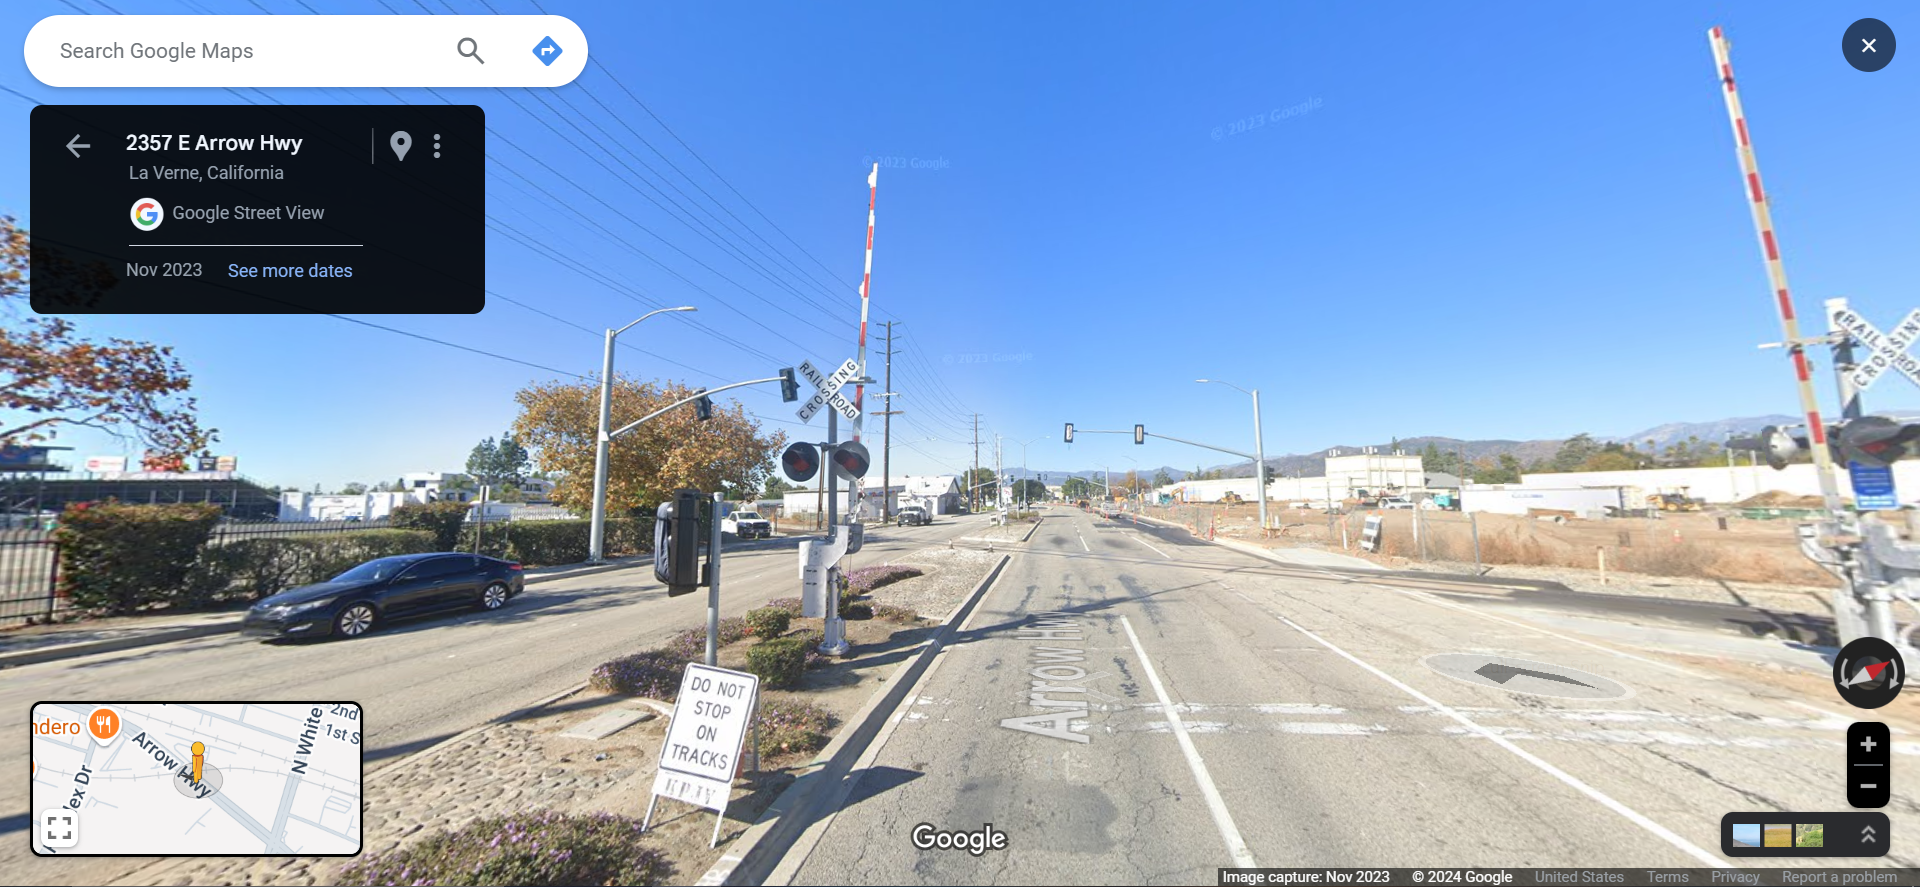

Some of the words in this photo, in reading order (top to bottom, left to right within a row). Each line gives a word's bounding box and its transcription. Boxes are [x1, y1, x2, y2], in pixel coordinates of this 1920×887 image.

[799, 361, 856, 420] CROSSING
[691, 676, 711, 693] DO
[717, 681, 746, 700] NOT
[693, 701, 731, 720] STOP
[696, 724, 718, 742] ON
[671, 743, 728, 770] TRACKS
